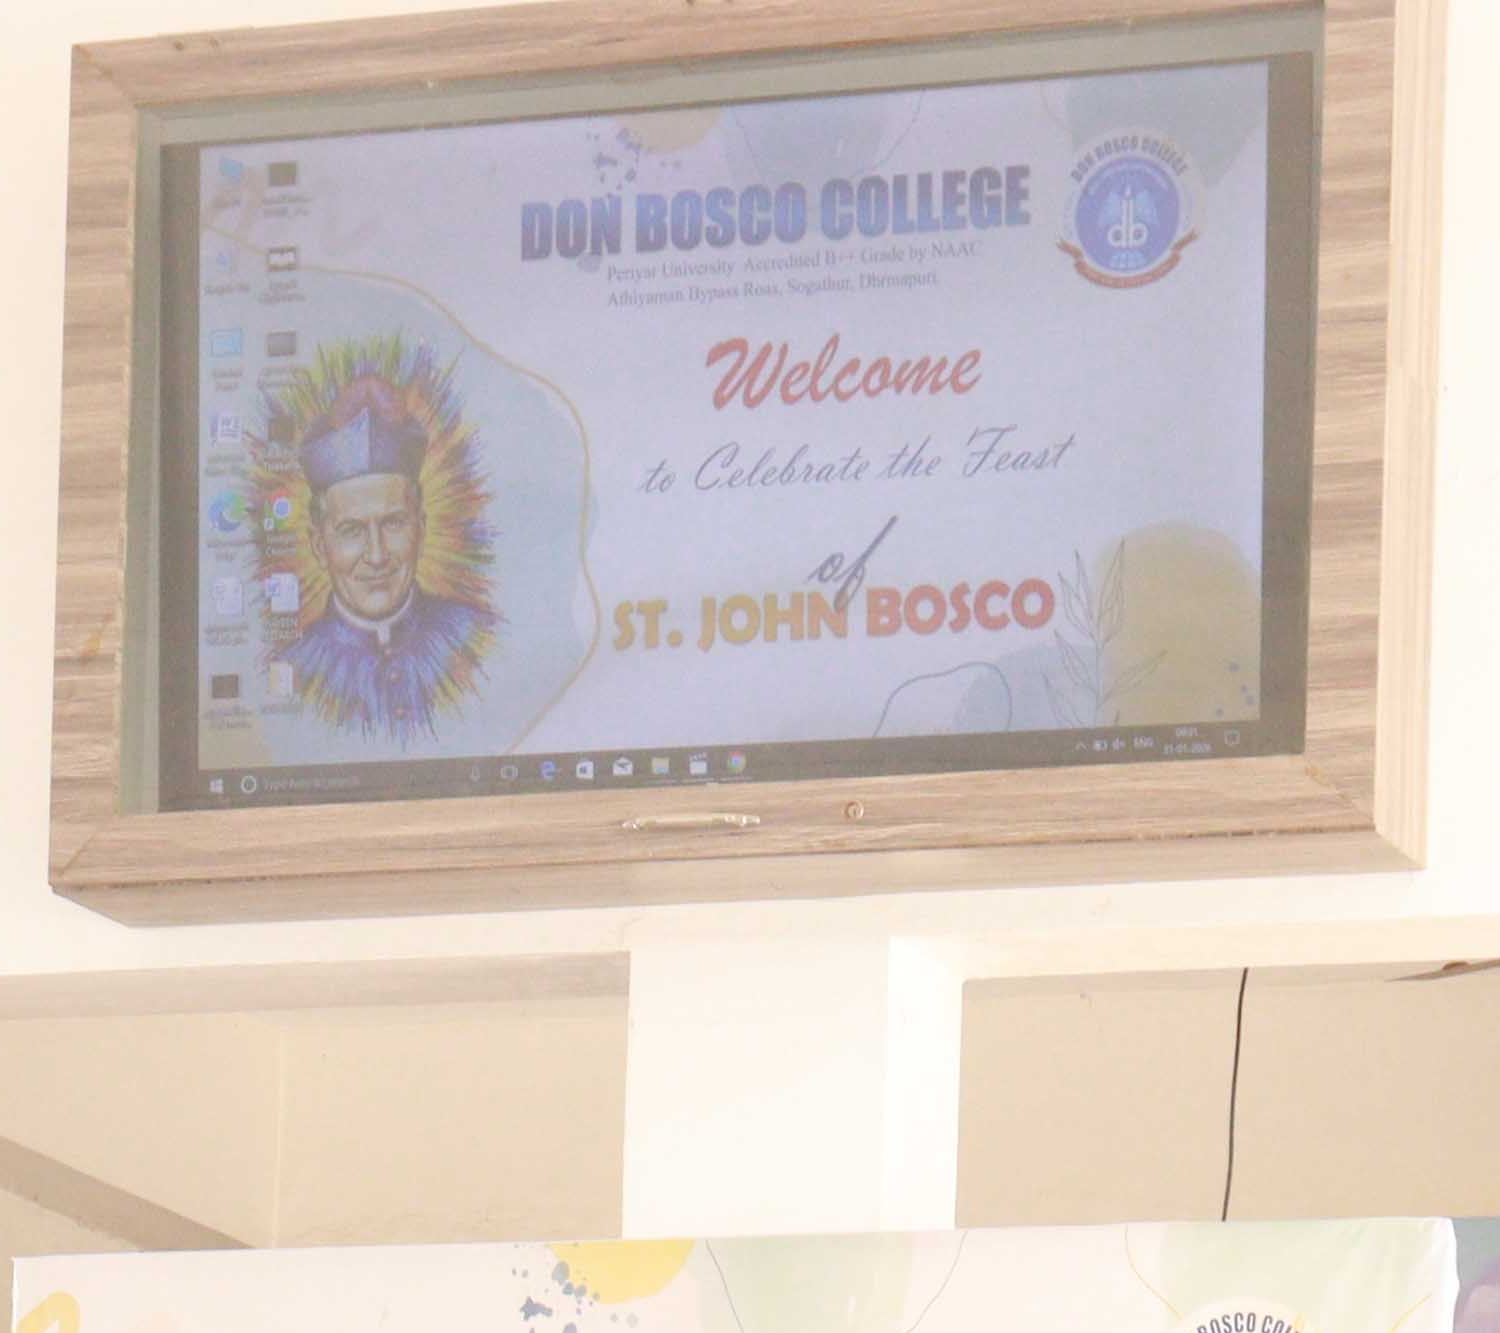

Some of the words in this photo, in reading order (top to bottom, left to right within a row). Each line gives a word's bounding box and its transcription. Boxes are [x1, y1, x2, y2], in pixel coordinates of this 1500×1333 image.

[521, 195, 622, 260] DON
[635, 182, 806, 253] BOSCO
[820, 164, 1030, 240] COLLEGE
[706, 332, 982, 410] Welcome
[638, 459, 676, 494] to
[695, 441, 870, 491] Celebrate
[876, 435, 941, 479] the
[962, 424, 1076, 478] Feast
[807, 515, 897, 612] of
[612, 598, 682, 651] ST.
[699, 591, 848, 651] JOHN
[866, 577, 1055, 637] BOSCO
